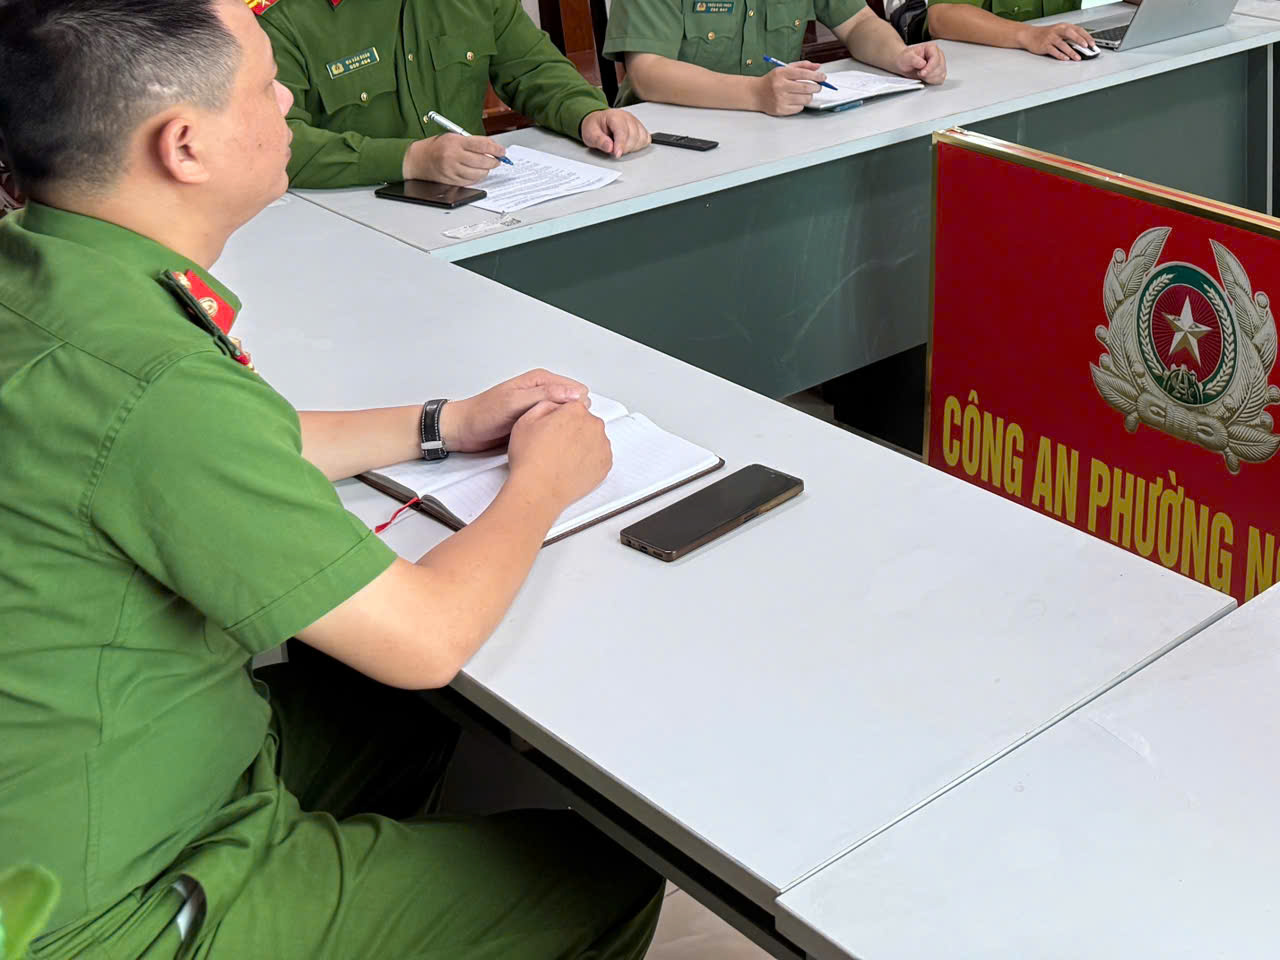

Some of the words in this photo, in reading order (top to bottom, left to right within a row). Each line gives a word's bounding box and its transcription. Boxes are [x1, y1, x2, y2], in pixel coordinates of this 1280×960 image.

[943, 389, 1024, 497] CÔNG
[1032, 436, 1079, 523] AN
[1088, 457, 1234, 595] PHƯỜNG
